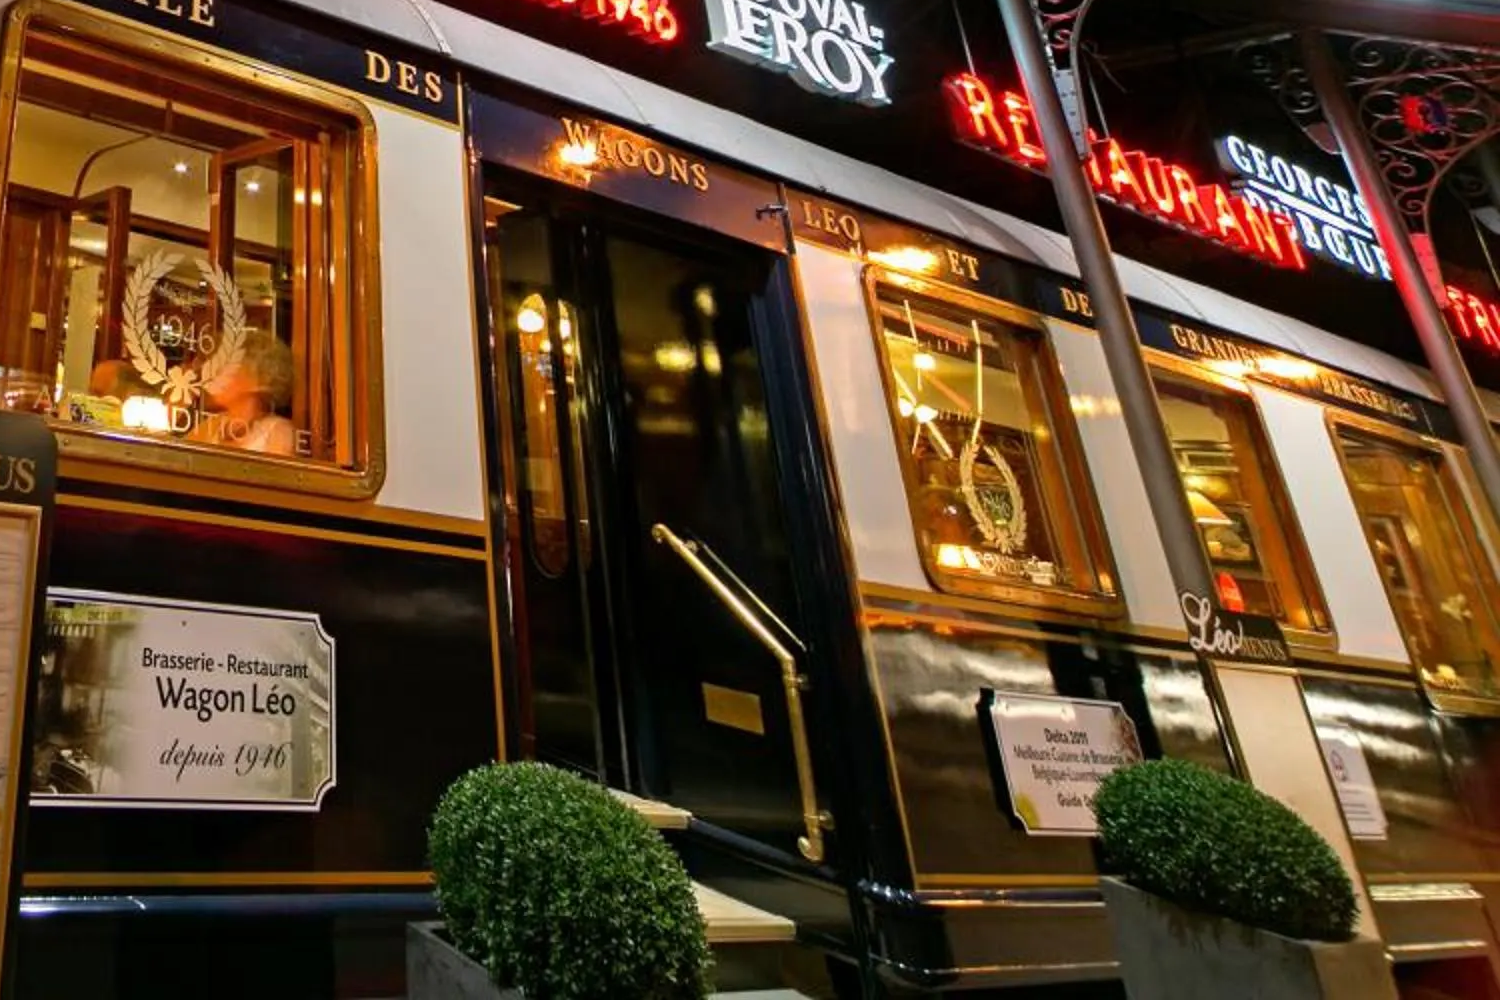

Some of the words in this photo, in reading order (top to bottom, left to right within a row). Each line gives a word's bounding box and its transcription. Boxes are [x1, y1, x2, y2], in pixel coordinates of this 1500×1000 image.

[365, 48, 443, 104] DES
[562, 117, 710, 193] WAGONS
[947, 247, 980, 282] ET
[1060, 287, 1094, 319] DE
[943, 72, 1308, 273] REAURANT
[155, 313, 215, 355] 1946
[141, 647, 216, 673] Brasserie
[226, 654, 310, 680] Restaurant
[155, 675, 246, 724] Wagon
[251, 683, 297, 717] Léo
[159, 738, 226, 784] depuis
[234, 740, 294, 778] 1946
